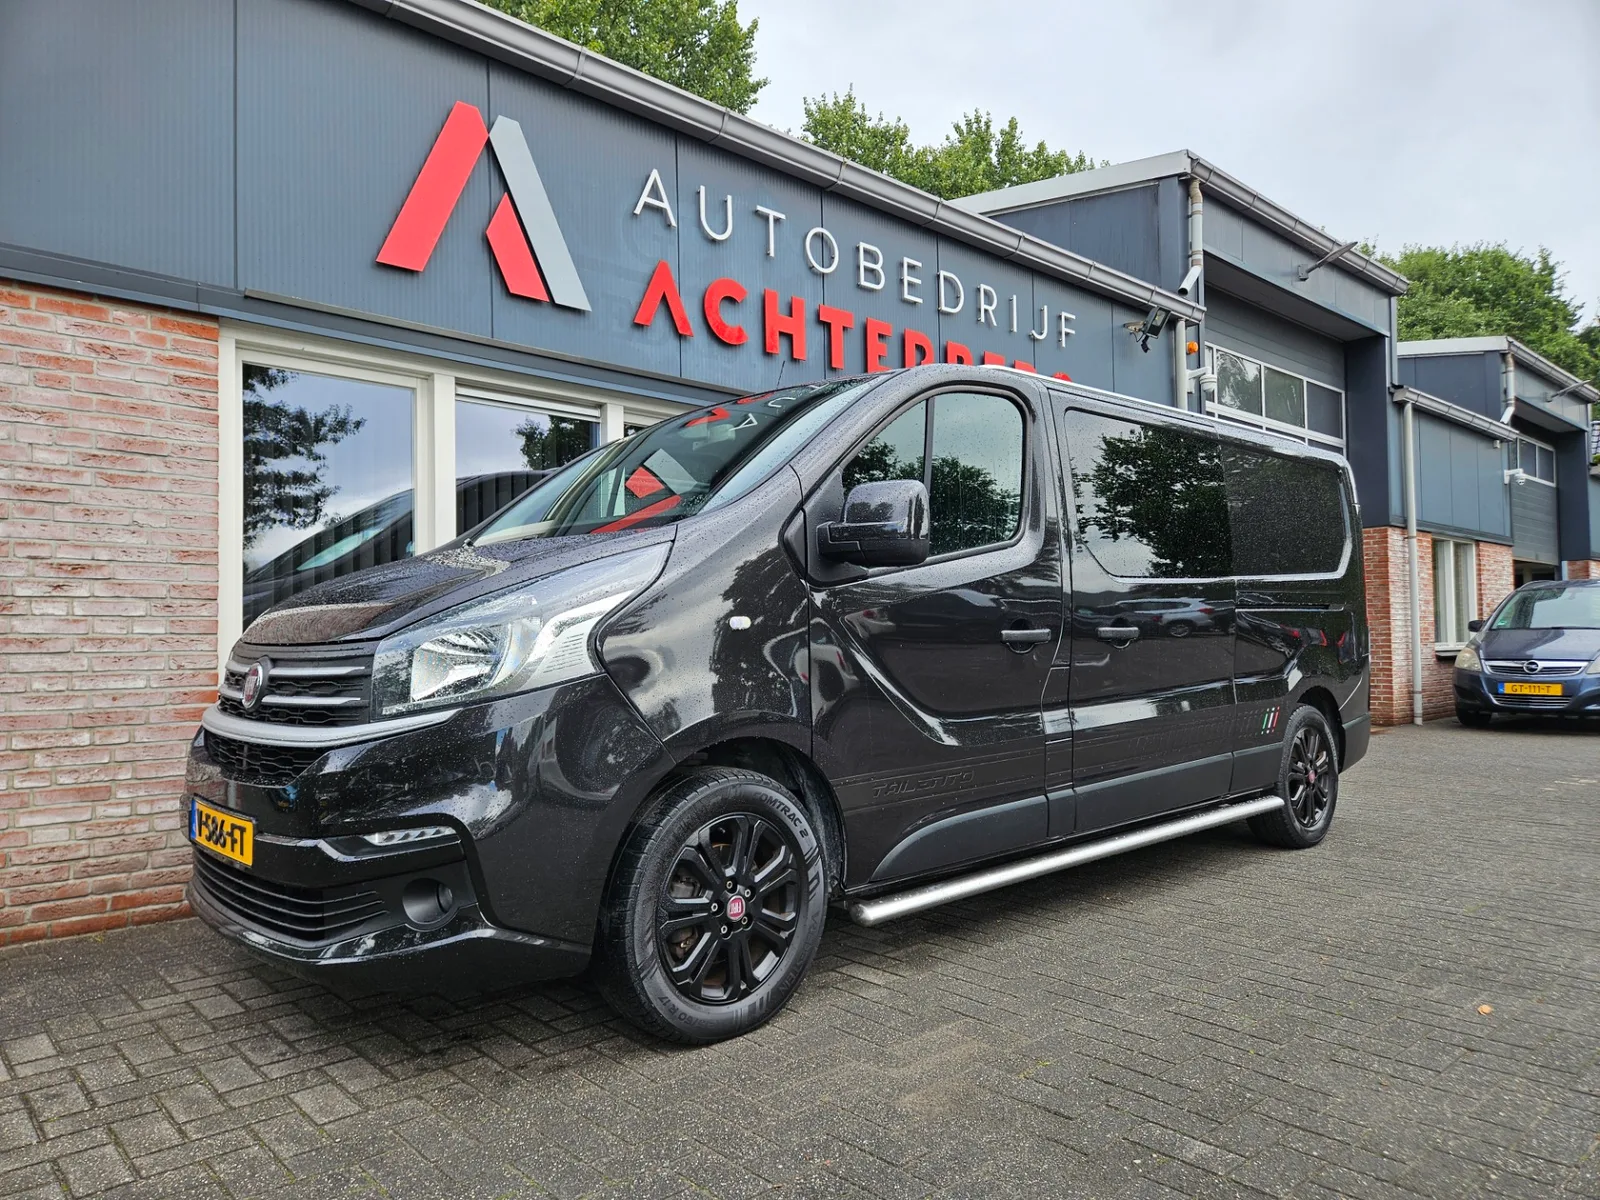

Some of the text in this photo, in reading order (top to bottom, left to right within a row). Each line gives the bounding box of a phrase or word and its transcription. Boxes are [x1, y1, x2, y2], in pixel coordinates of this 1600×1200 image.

[632, 168, 1077, 348] AUTOBEDRIJF
[1511, 684, 1552, 694] GT-111-T
[872, 769, 975, 798] TALENTO
[799, 828, 809, 838] 2
